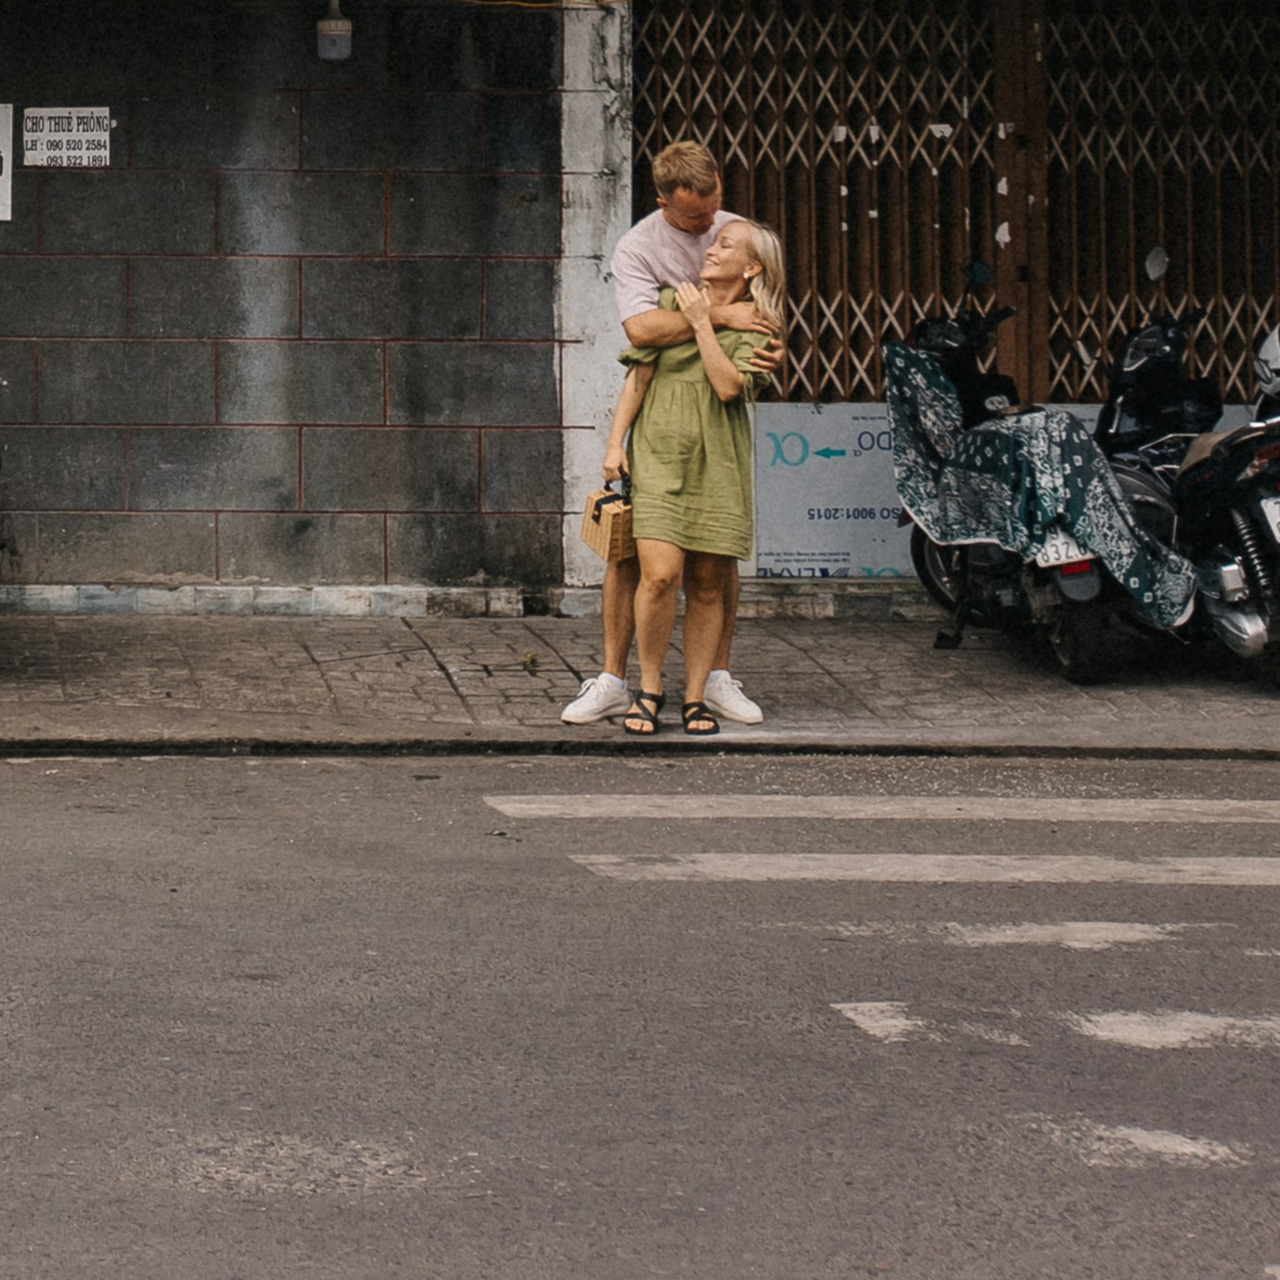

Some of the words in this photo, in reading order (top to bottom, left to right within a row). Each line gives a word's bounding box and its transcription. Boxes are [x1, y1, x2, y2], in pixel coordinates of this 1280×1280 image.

[24, 116, 45, 133] CHO
[76, 111, 109, 133] PHÒNG
[25, 140, 38, 151] LH
[46, 139, 64, 151] 090
[66, 139, 84, 151] 520
[85, 139, 108, 151] 2584
[46, 155, 64, 166] 093
[66, 155, 84, 166] 522
[87, 155, 108, 166] 1891
[806, 507, 876, 521] 9001:2015
[880, 507, 902, 521] SO
